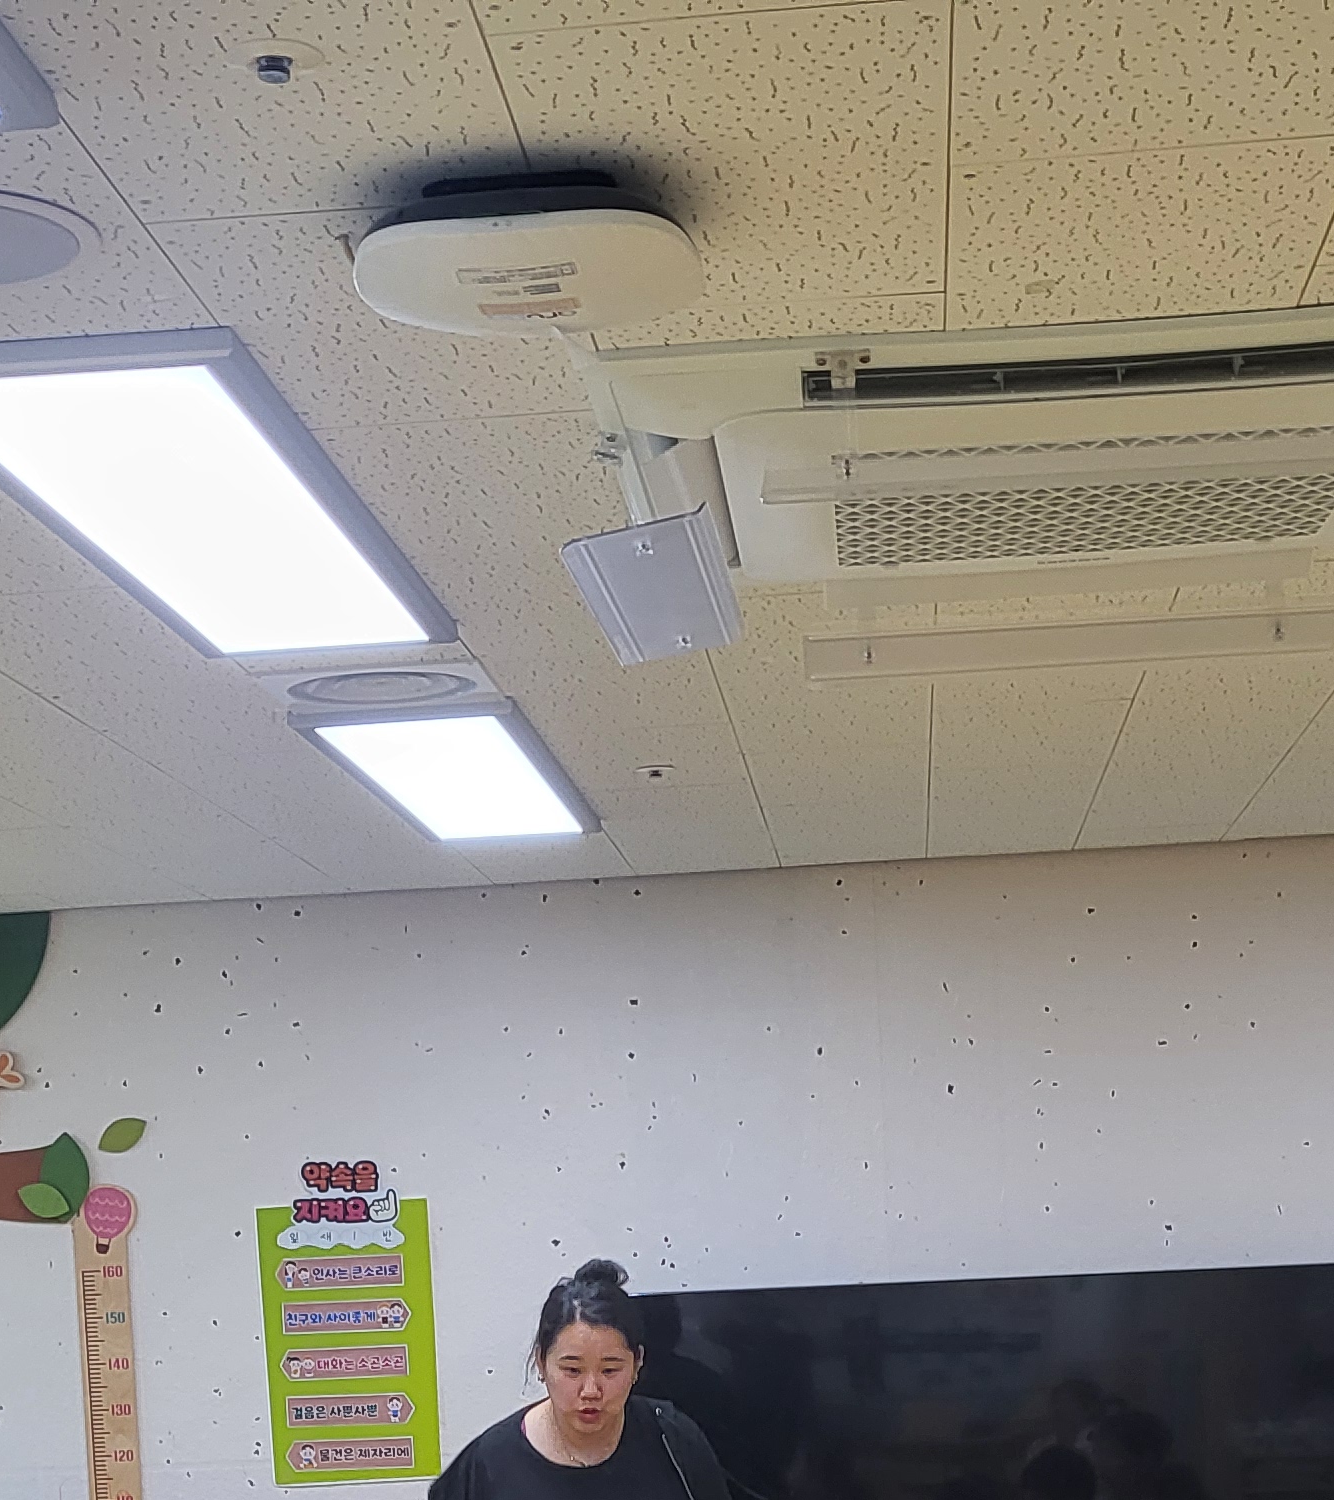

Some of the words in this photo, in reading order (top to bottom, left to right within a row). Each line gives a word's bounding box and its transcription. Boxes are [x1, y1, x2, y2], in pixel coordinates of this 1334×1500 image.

[301, 1160, 379, 1193] 약속을
[293, 1197, 369, 1223] 지켜요
[102, 1265, 123, 1278] 160
[312, 1267, 349, 1281] 인사는
[352, 1264, 399, 1280] 큰소리로
[105, 1311, 126, 1324] 150
[286, 1312, 323, 1328] 친구와
[108, 1357, 130, 1370] 140
[317, 1358, 355, 1371] 대화는
[358, 1355, 404, 1370] 소곤소곤
[111, 1403, 132, 1416] 130
[292, 1406, 326, 1420] 걸음은
[330, 1404, 378, 1418] 사뿐사뿐
[113, 1449, 134, 1462] 120
[319, 1448, 355, 1462] 물건은
[357, 1446, 410, 1459] 제자리에
